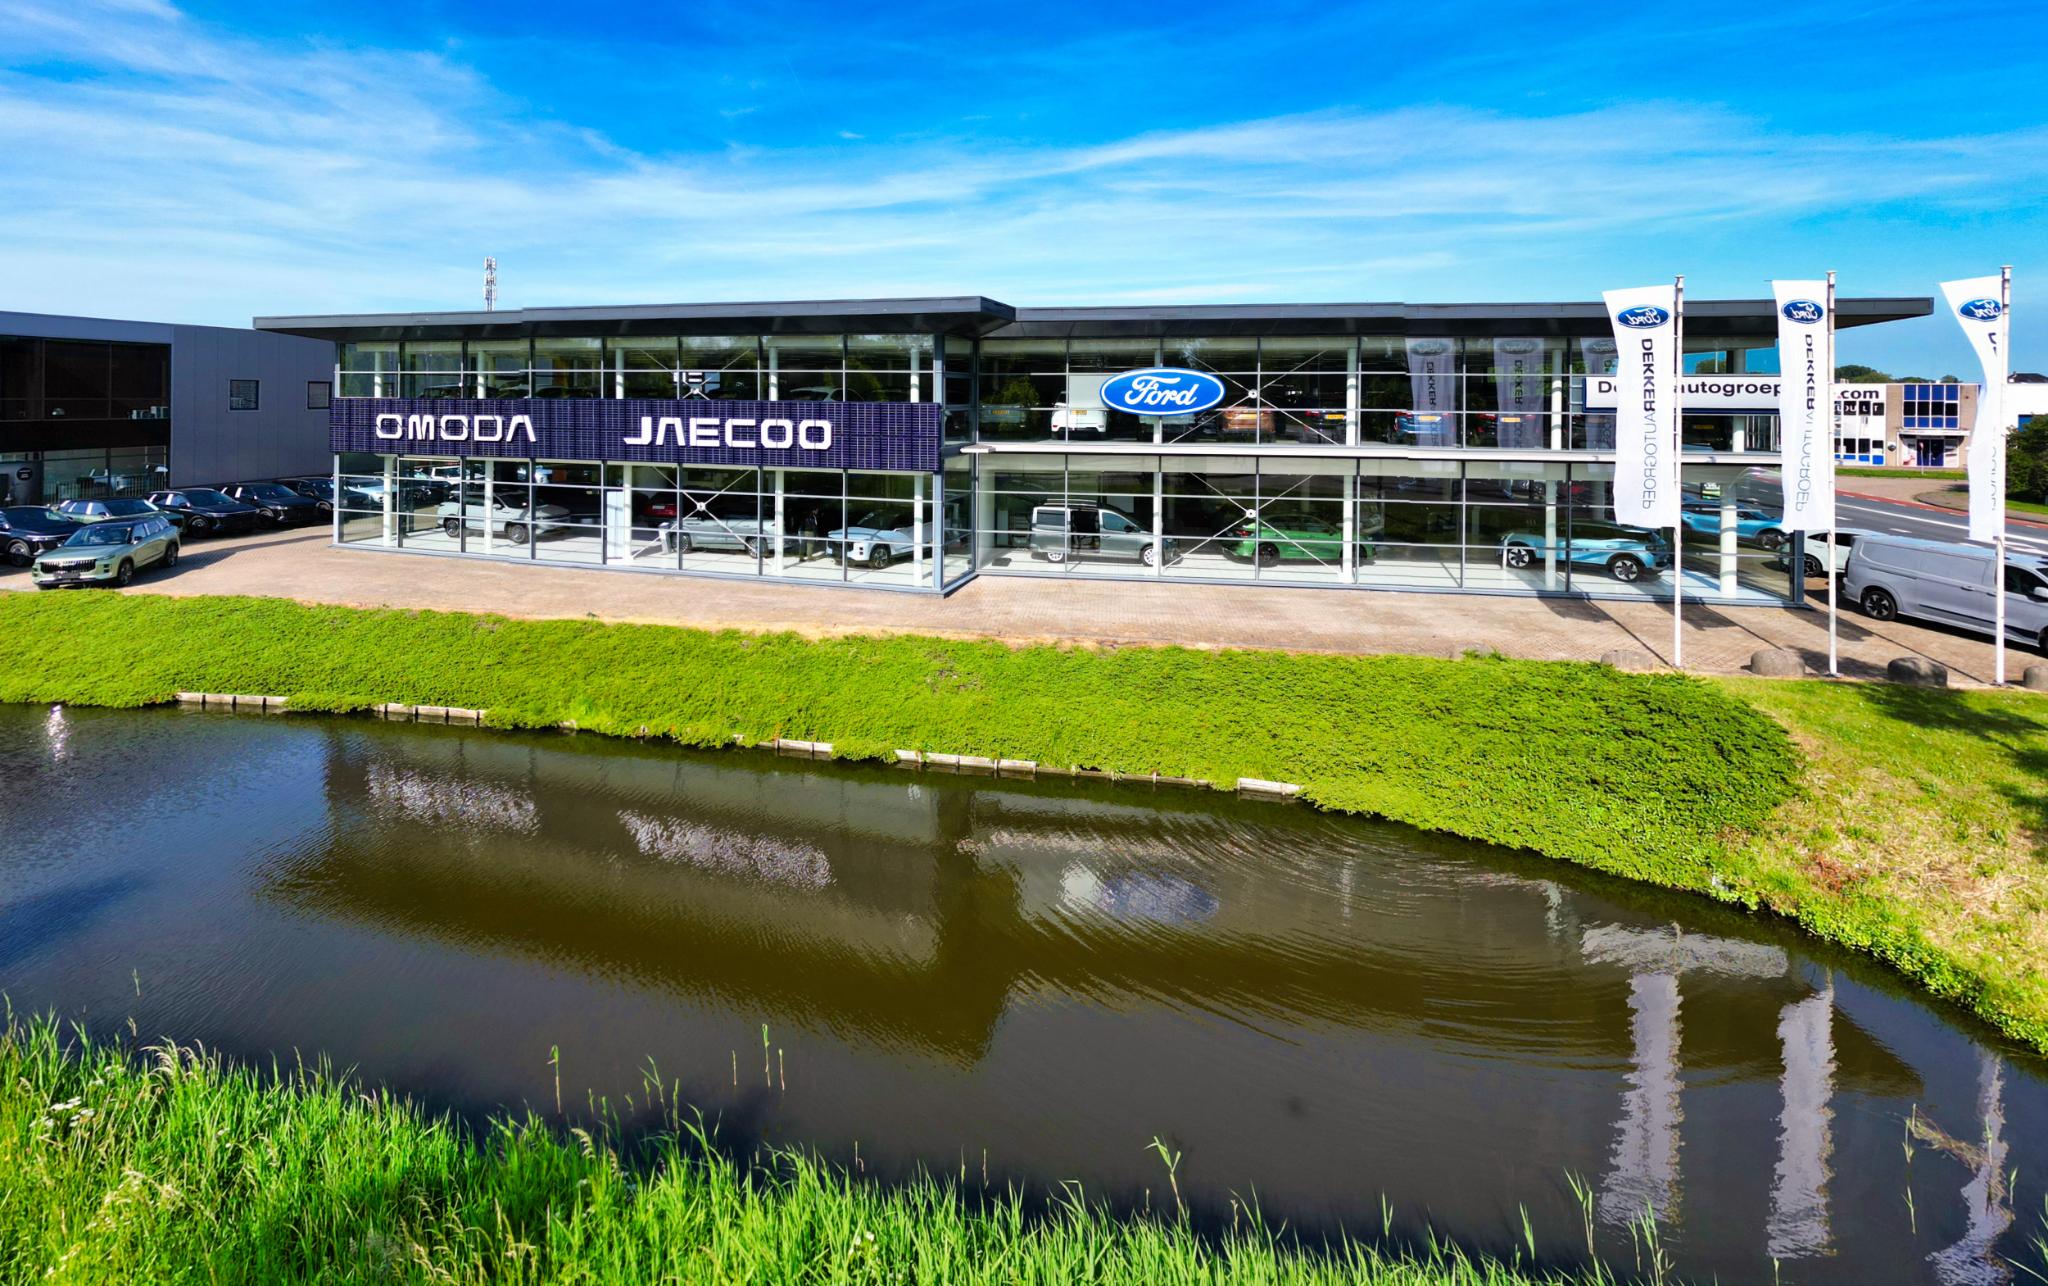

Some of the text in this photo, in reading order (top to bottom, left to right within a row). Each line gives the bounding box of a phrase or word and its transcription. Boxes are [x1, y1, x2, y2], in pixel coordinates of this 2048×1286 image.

[1124, 376, 1199, 405] Ford
[376, 413, 537, 442] OMODA
[623, 416, 832, 450] JAECOO
